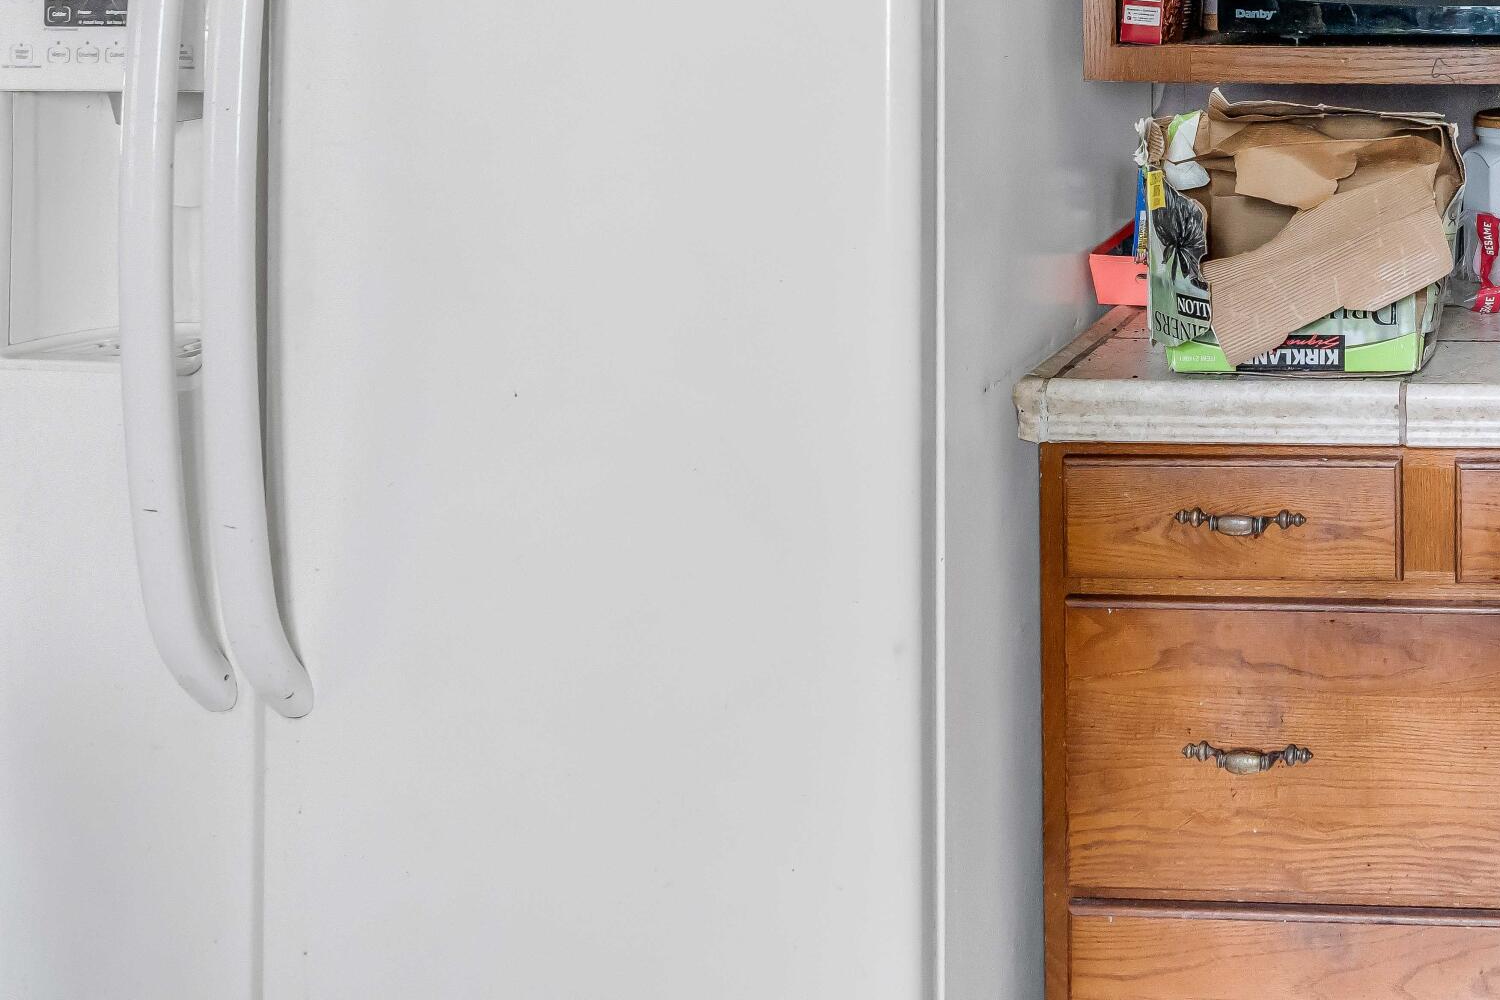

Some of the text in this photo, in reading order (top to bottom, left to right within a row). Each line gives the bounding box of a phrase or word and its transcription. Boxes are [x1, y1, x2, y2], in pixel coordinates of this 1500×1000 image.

[1235, 8, 1275, 20] Danby
[1484, 221, 1494, 255] SESAME
[1243, 347, 1339, 365] KIRKLAN
